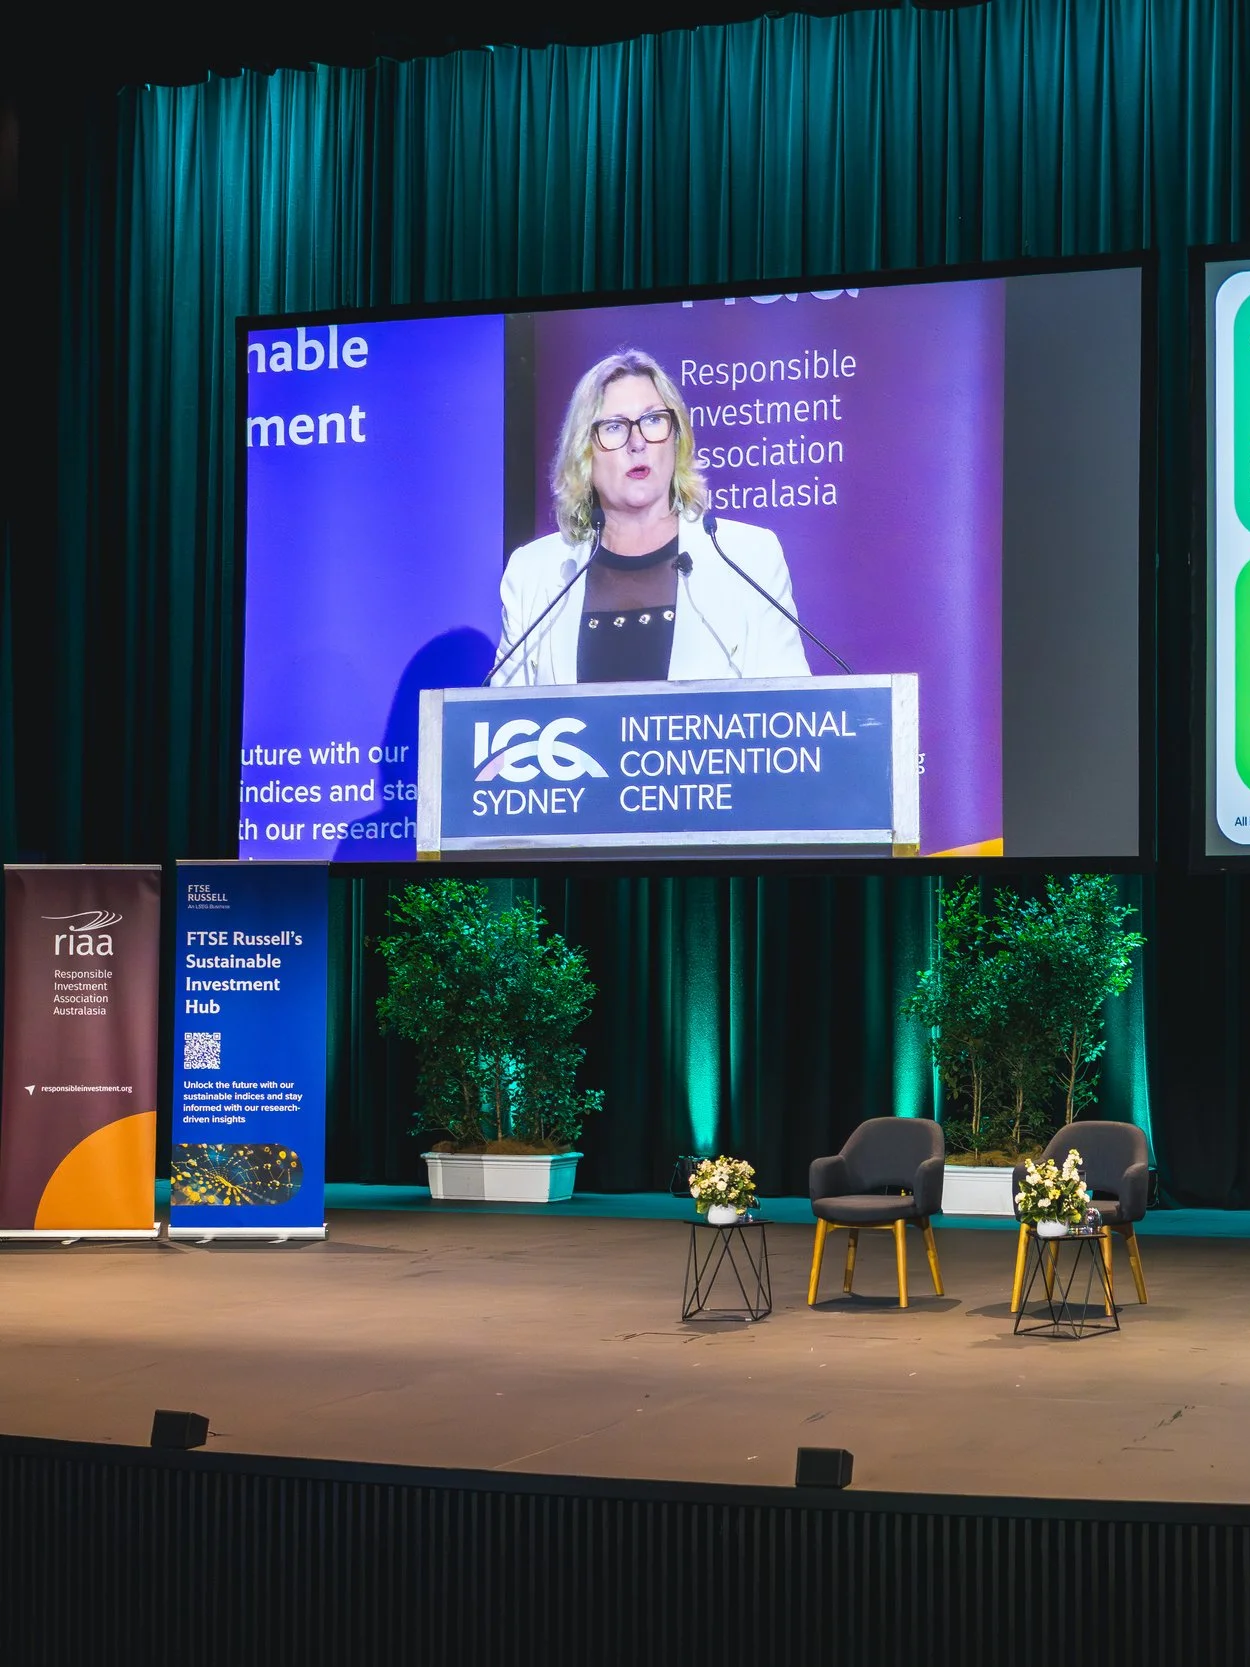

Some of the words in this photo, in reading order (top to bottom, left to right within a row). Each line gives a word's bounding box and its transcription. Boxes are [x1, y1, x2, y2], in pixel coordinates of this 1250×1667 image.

[682, 349, 856, 390] Responsible
[622, 711, 856, 741] INTERNATIONAL
[309, 742, 359, 764] with
[368, 744, 408, 764] our
[621, 747, 820, 777] CONVENTION
[330, 779, 374, 802] and
[620, 784, 732, 811] CENTRE
[473, 788, 585, 816] SYDNEY
[1235, 817, 1247, 826] All
[265, 824, 305, 840] our
[54, 925, 114, 956] riaa
[188, 932, 228, 945] FTSE
[186, 954, 281, 968] Sustainable
[55, 969, 112, 980] Responsible
[186, 977, 280, 991] Investment
[54, 994, 108, 1003] Association
[53, 1006, 106, 1015] Australasia
[186, 999, 220, 1013] Hub
[42, 1085, 132, 1093] responsibleinvestment.org
[235, 1092, 265, 1100] indices
[285, 1093, 302, 1101] stay
[212, 1115, 245, 1124] insights
